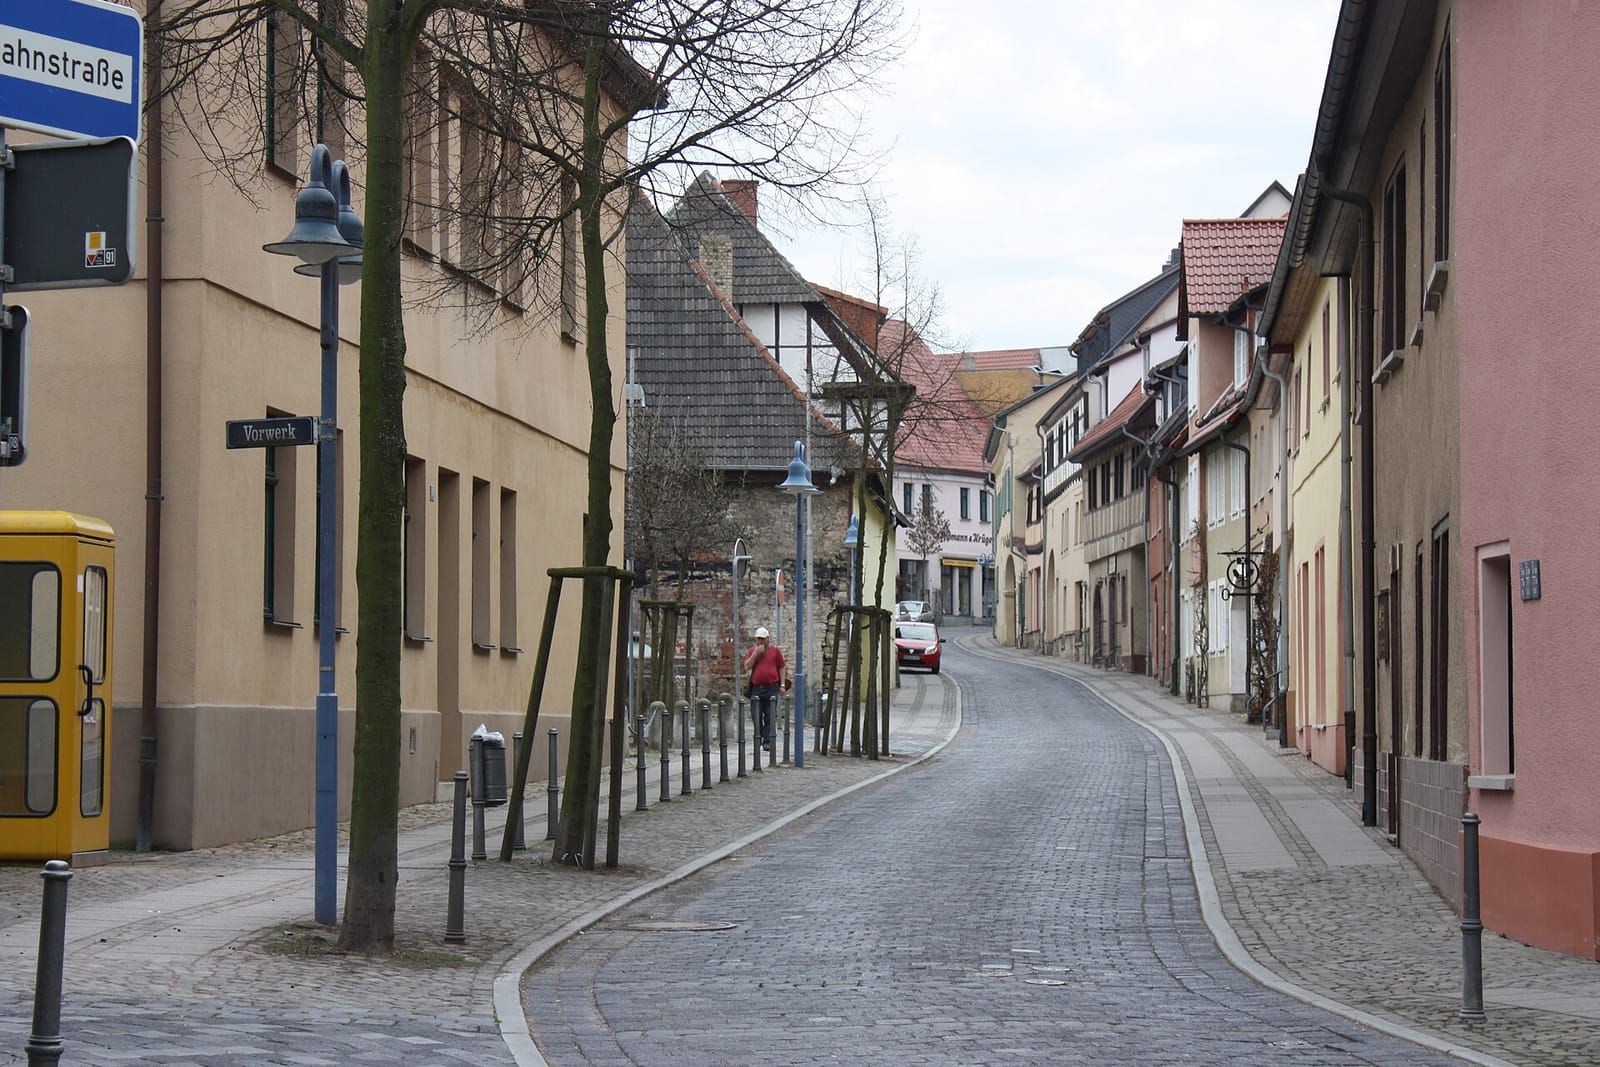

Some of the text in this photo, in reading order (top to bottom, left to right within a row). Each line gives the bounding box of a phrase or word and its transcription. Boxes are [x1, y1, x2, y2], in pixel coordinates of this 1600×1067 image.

[2, 39, 124, 90] ahnstraße
[105, 251, 114, 264] 91
[243, 423, 296, 441] Vorwerk
